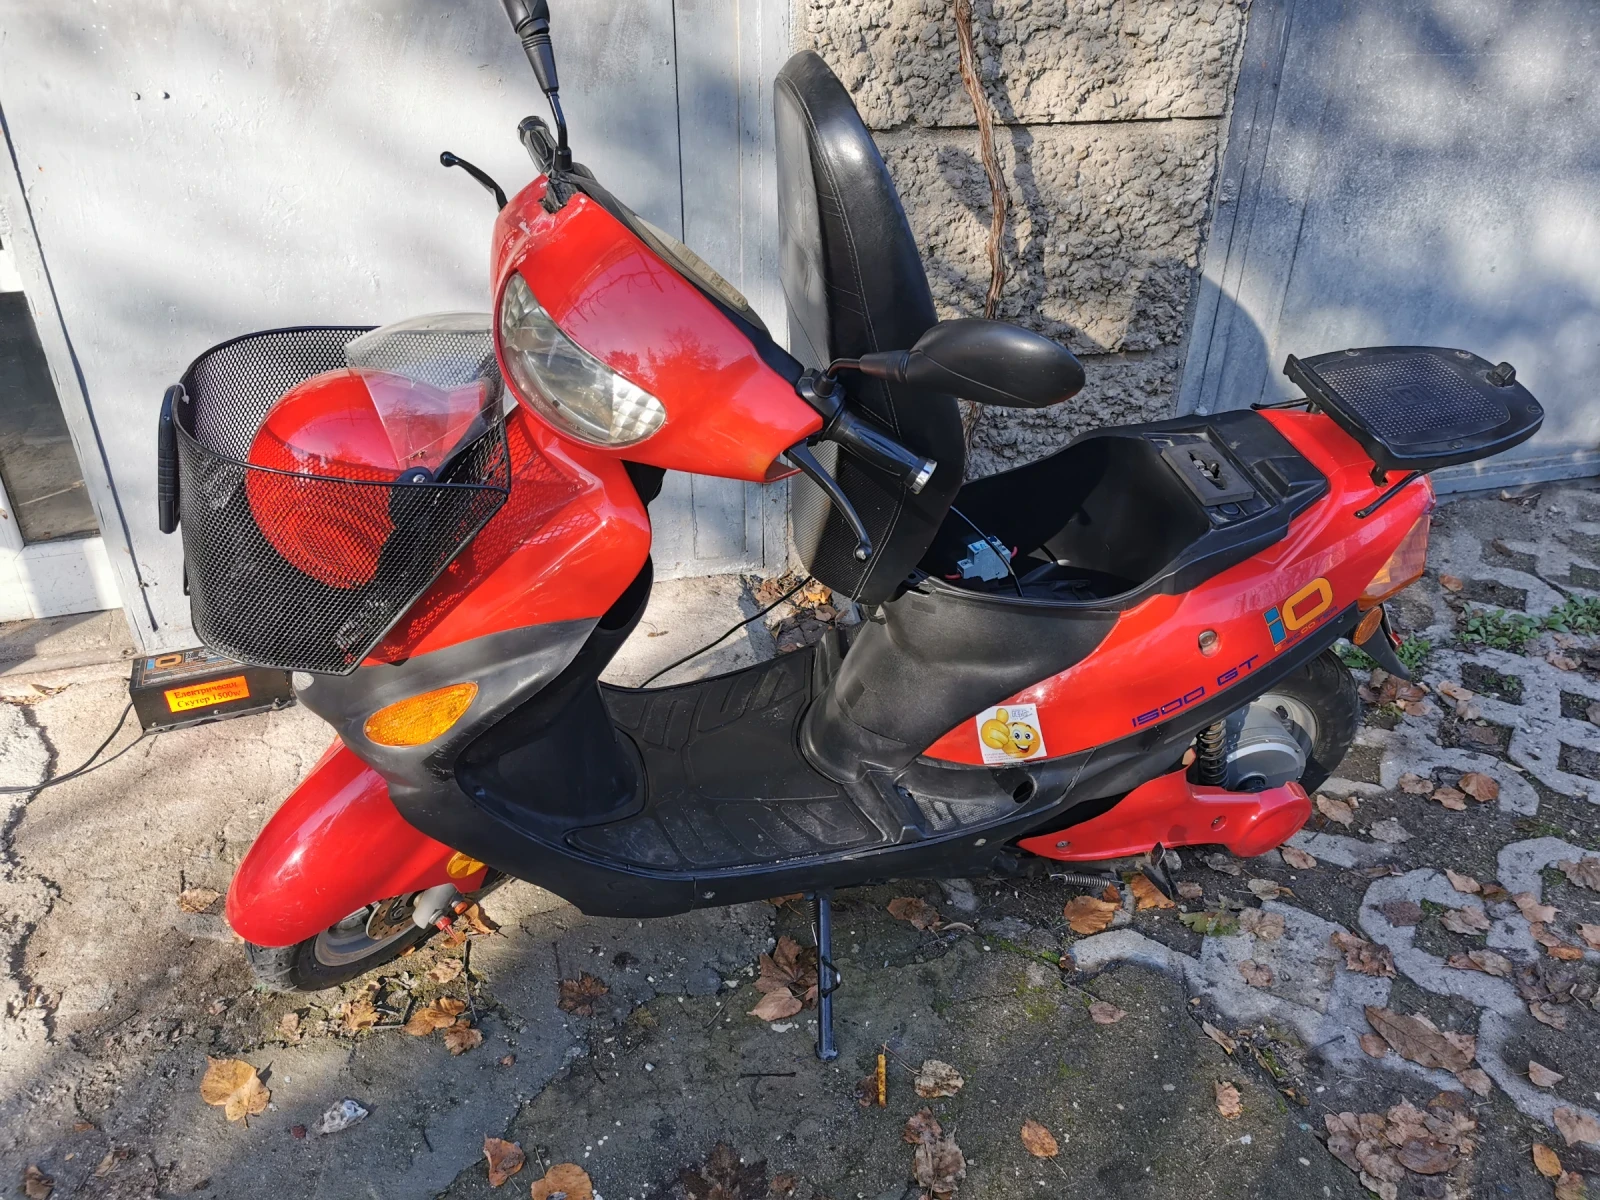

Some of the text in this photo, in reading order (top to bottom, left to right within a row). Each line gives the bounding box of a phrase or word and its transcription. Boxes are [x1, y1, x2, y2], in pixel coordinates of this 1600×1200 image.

[174, 681, 238, 699] Електрически
[1131, 654, 1259, 728] 1500 GT
[177, 696, 211, 707] Скутер
